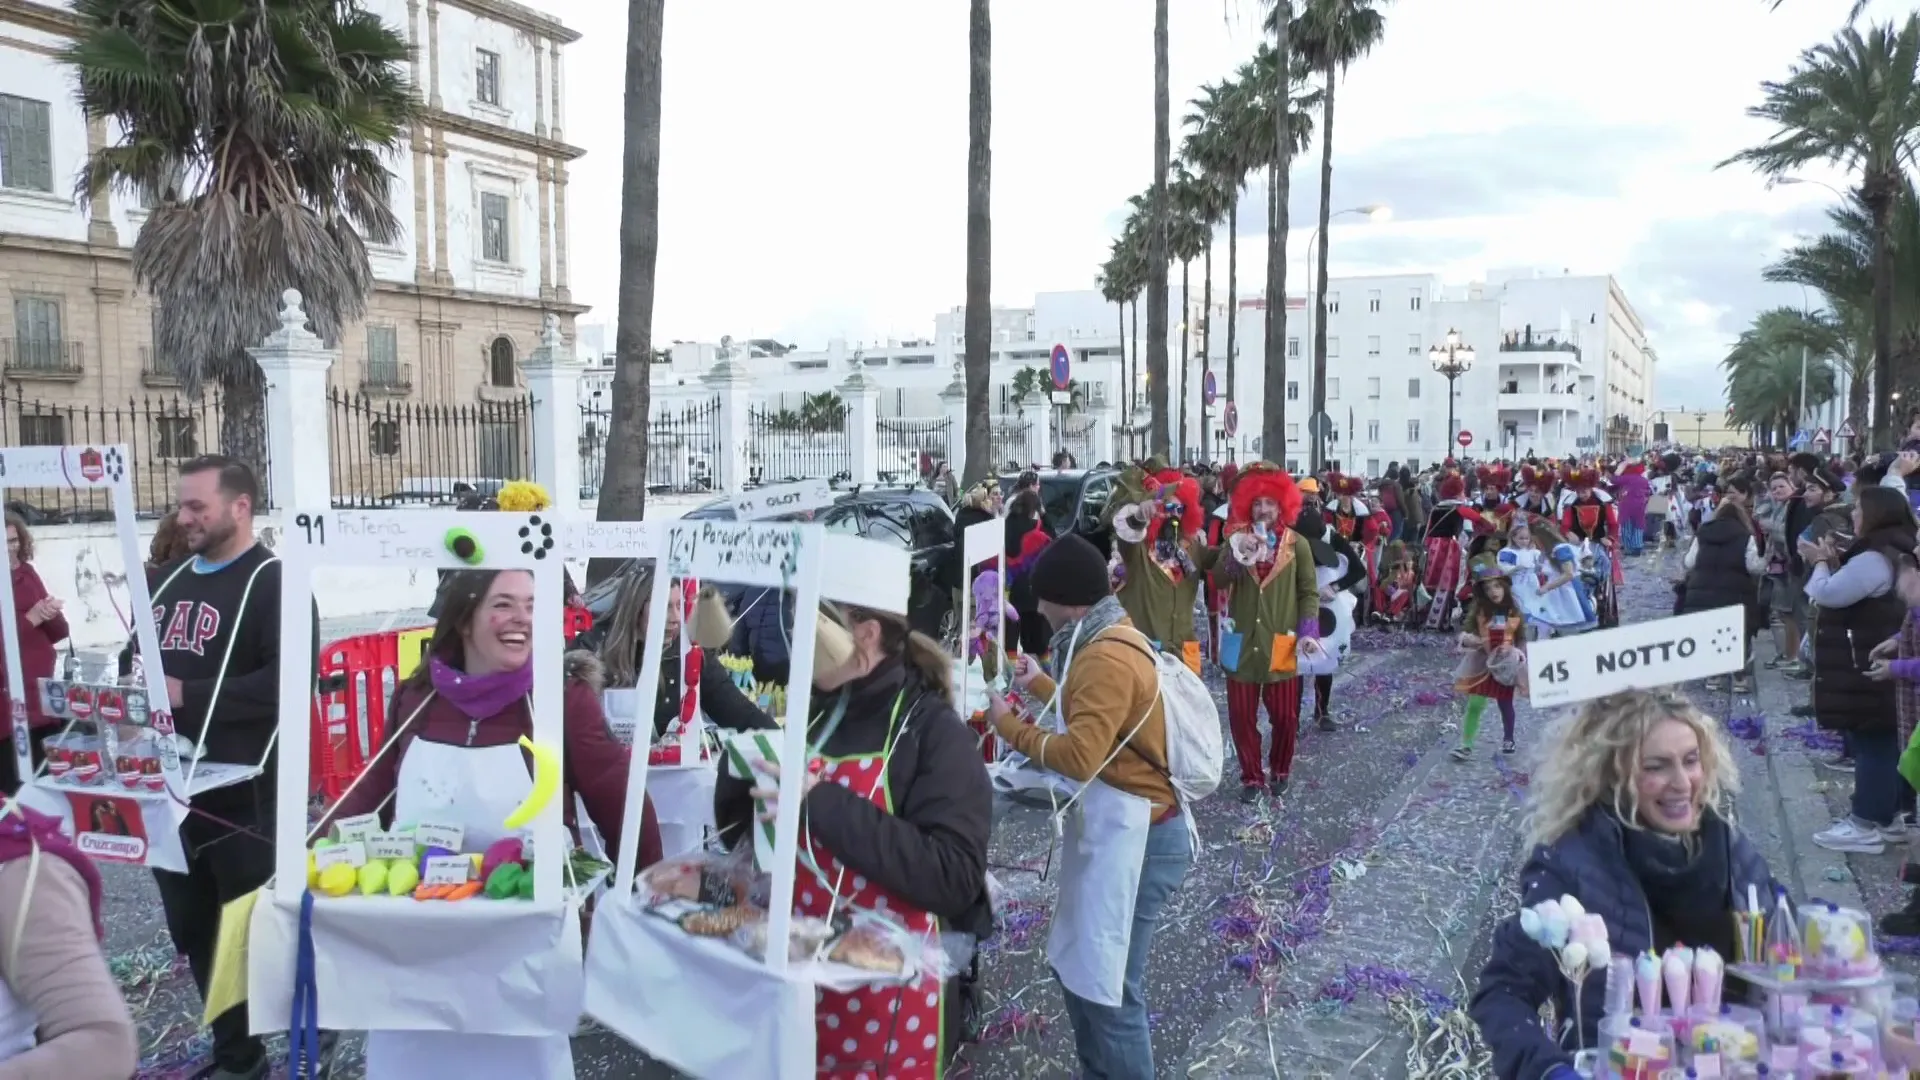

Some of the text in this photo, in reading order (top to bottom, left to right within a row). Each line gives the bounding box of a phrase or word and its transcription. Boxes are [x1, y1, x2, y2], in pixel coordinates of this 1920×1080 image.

[295, 513, 324, 545] 91
[587, 522, 648, 539] Boutique
[379, 540, 435, 558] Irene
[1538, 637, 1697, 684] 45 NOTTO
[82, 831, 141, 854] Cruzcampo
